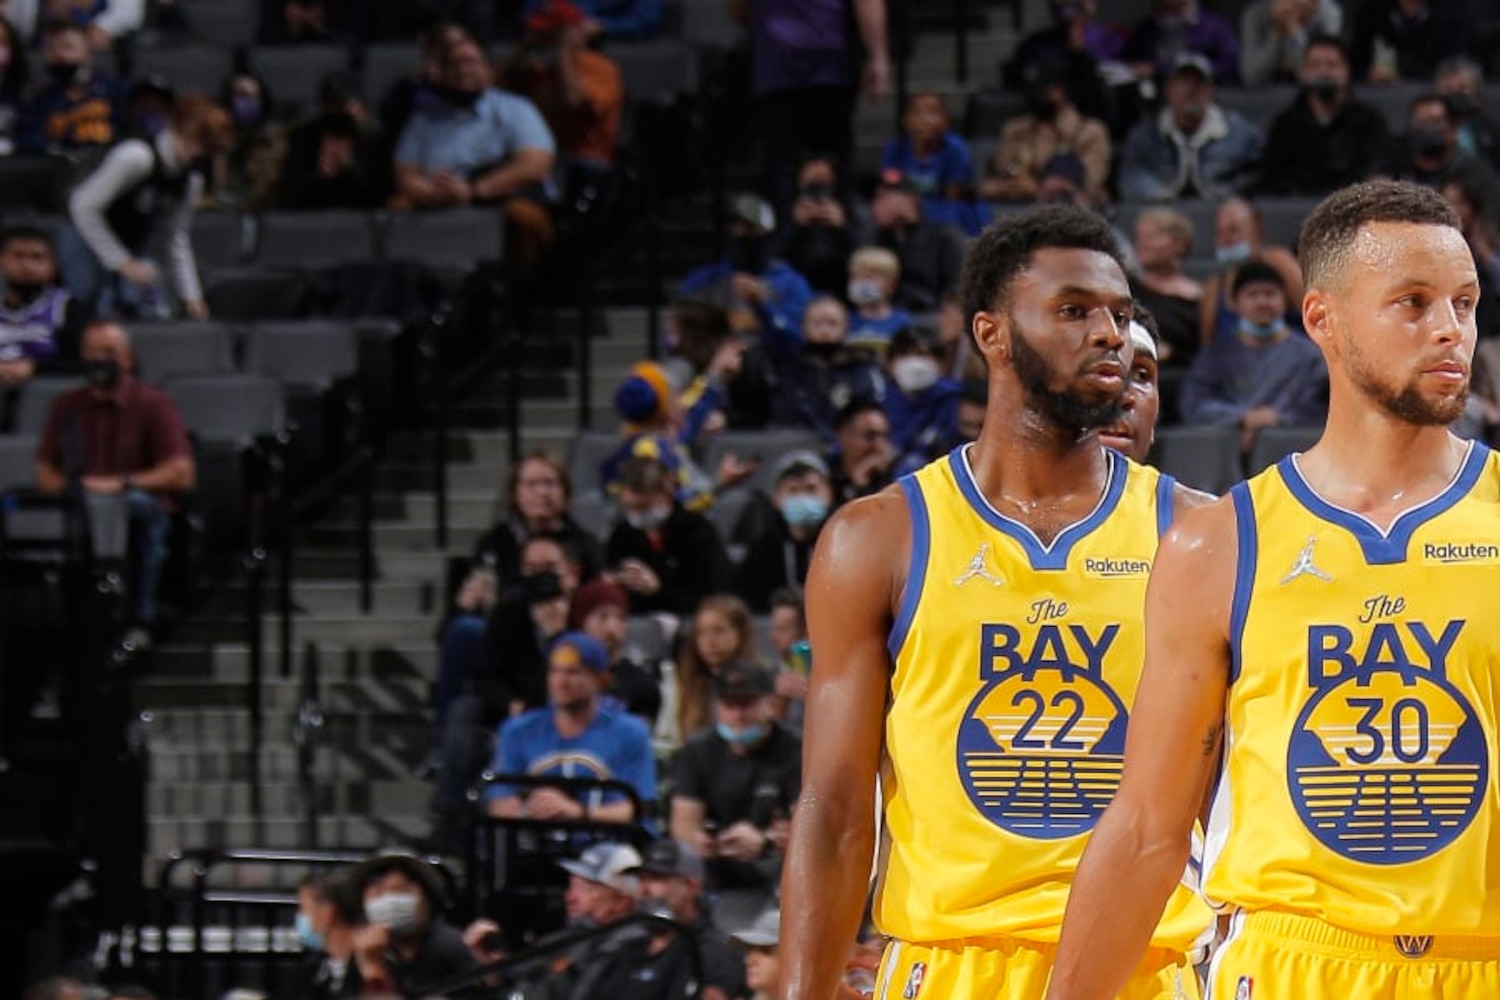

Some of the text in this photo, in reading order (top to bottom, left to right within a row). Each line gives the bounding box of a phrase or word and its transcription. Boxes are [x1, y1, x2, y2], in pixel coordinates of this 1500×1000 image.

[1086, 558, 1150, 574] Rakuten
[1424, 543, 1499, 561] Rakuten
[1026, 598, 1069, 624] The
[1358, 596, 1406, 624] The
[979, 623, 1121, 683] BAY
[1307, 619, 1467, 688] BAY
[1010, 689, 1085, 751] 22
[1344, 697, 1430, 764] 30
